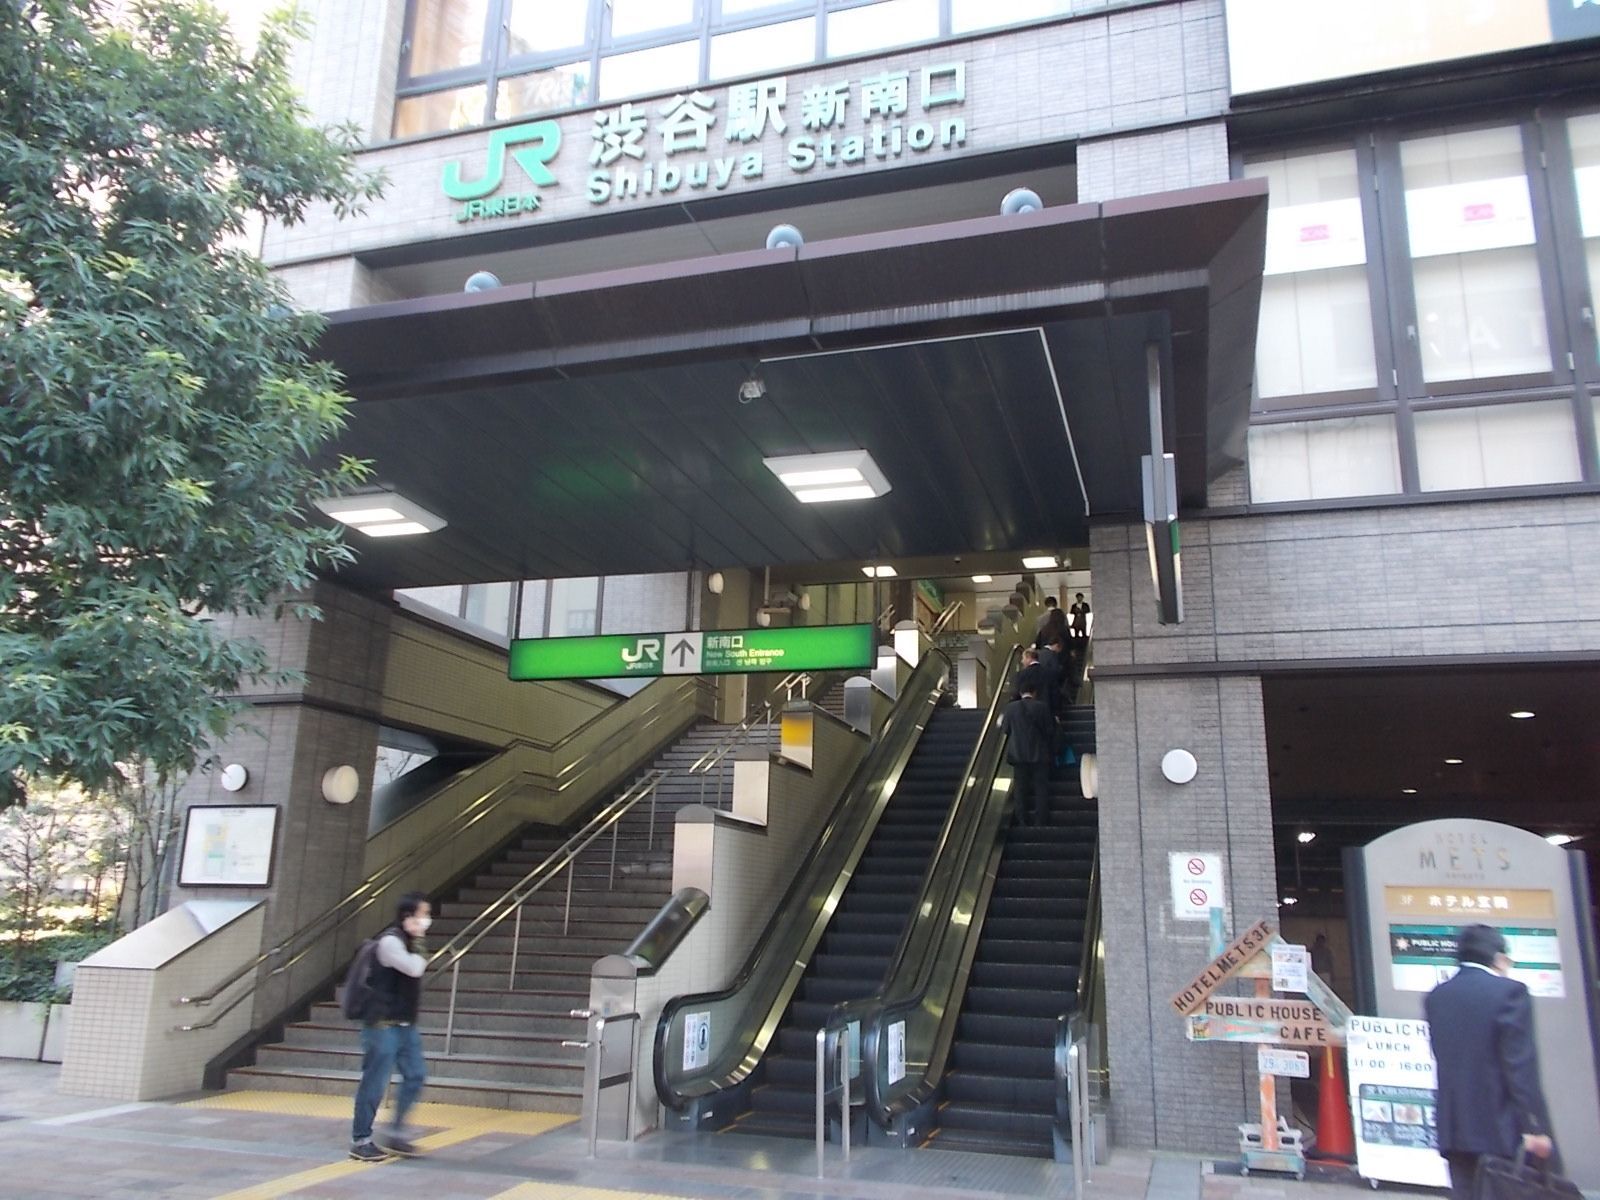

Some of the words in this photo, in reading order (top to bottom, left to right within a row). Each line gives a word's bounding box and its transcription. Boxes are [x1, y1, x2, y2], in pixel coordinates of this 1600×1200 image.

[442, 119, 561, 201] JR
[587, 150, 764, 205] Shibuya
[787, 117, 967, 172] Station
[621, 638, 661, 663] JR
[724, 649, 748, 658] South
[1419, 847, 1511, 871] METS
[1411, 939, 1440, 948] PUBLIC
[1205, 1001, 1265, 1018] PUBLIC
[1270, 1005, 1323, 1022] HOUSE
[1280, 1026, 1327, 1041] CAFE
[1351, 1019, 1411, 1036] PUBLIC
[1367, 1041, 1411, 1052] LUNCH
[1353, 1057, 1386, 1069] 1100
[1399, 1061, 1433, 1073] 1600
